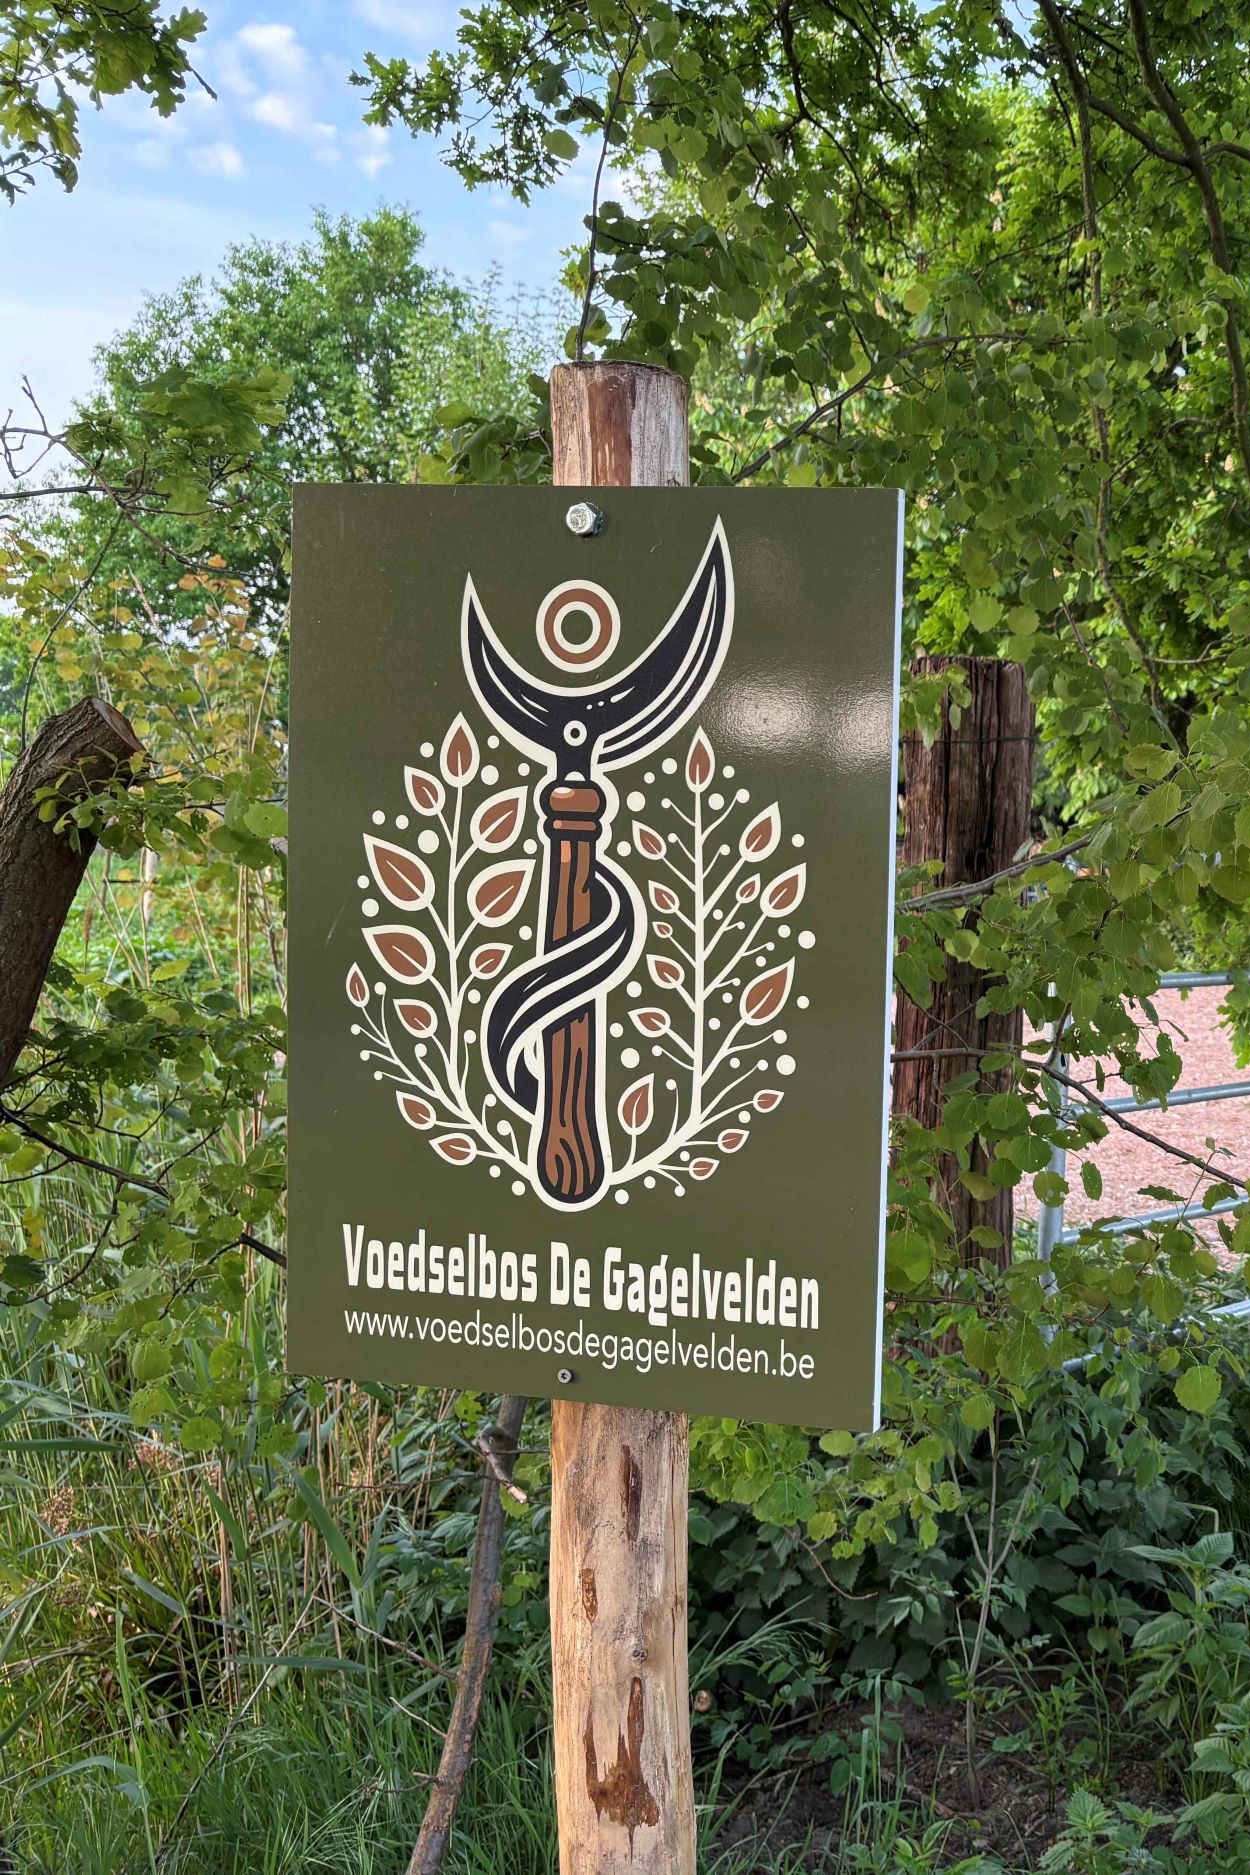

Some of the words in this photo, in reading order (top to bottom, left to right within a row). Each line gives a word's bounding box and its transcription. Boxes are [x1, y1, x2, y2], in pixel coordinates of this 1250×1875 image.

[342, 1223, 538, 1303] Voedselbos
[550, 1241, 591, 1308] De
[603, 1246, 819, 1330] Gagelvelden
[344, 1309, 815, 1379] www.voedselbosdegagelvelden.be
